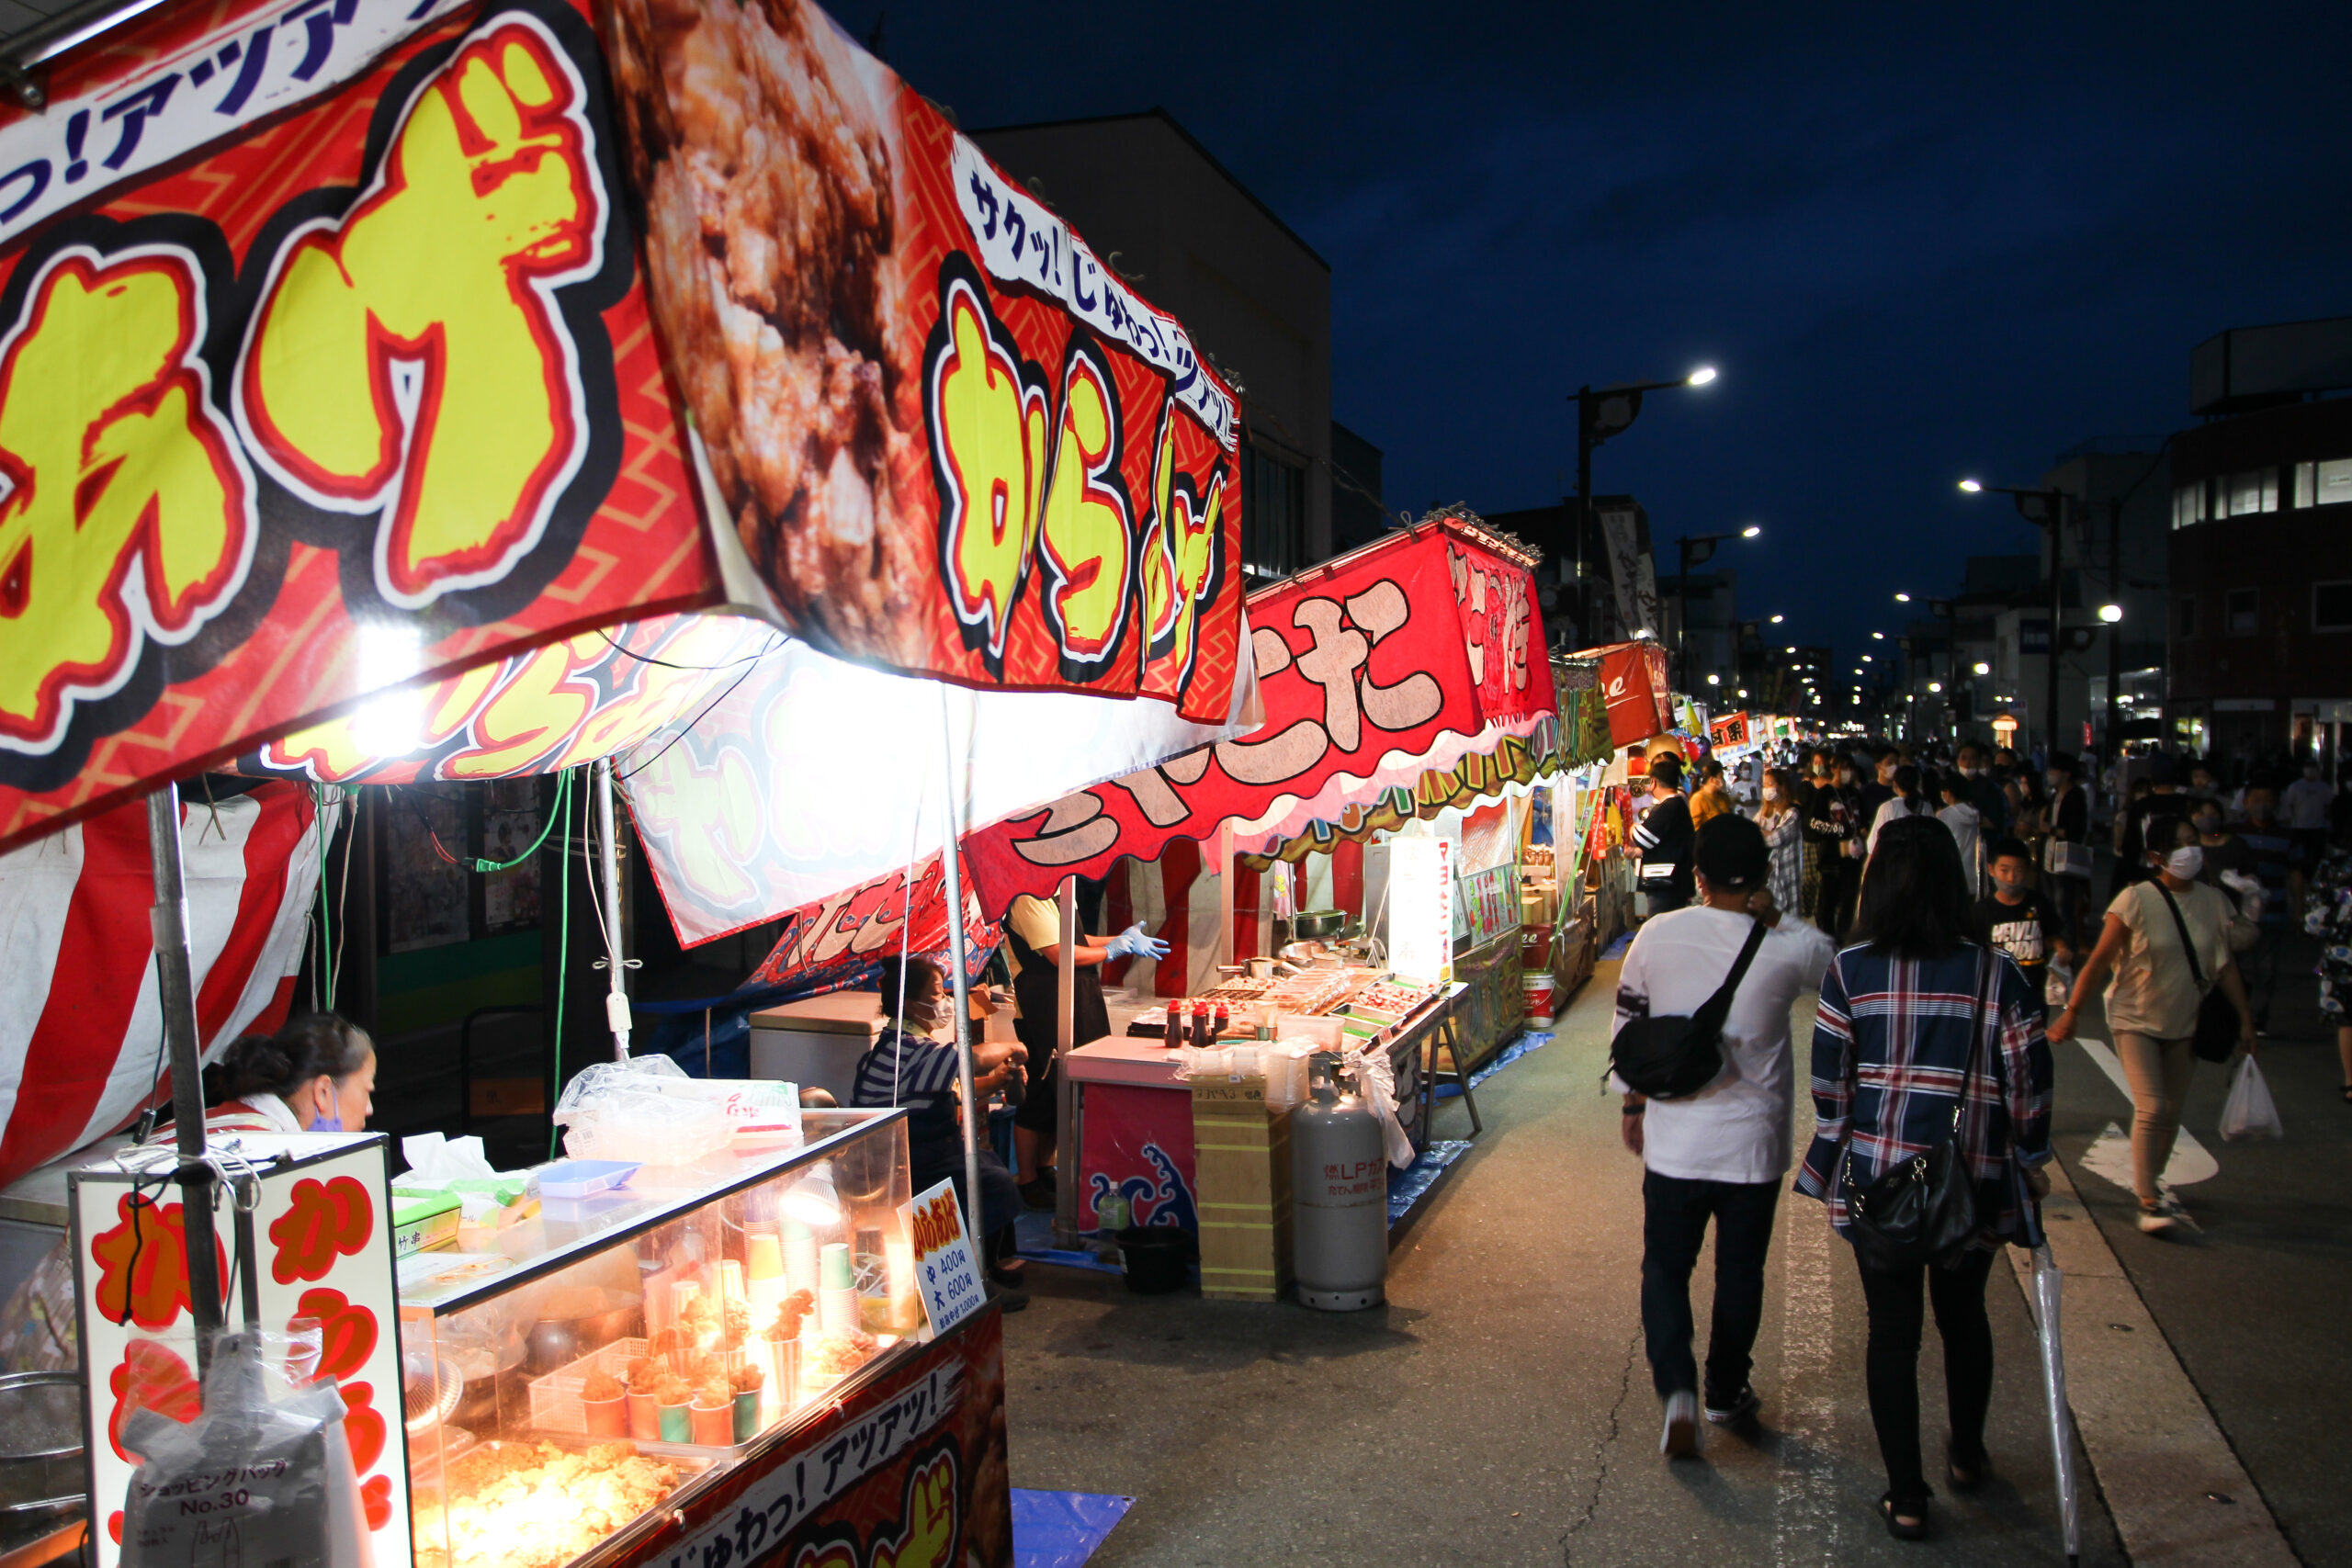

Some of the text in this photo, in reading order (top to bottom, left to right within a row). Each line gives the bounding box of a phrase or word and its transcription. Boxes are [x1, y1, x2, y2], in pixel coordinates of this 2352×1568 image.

[397, 1231, 423, 1251] 竹串
[926, 1248, 966, 1285] 中 400円
[933, 1271, 973, 1311] 大 600円
[180, 1488, 250, 1516] No.30
